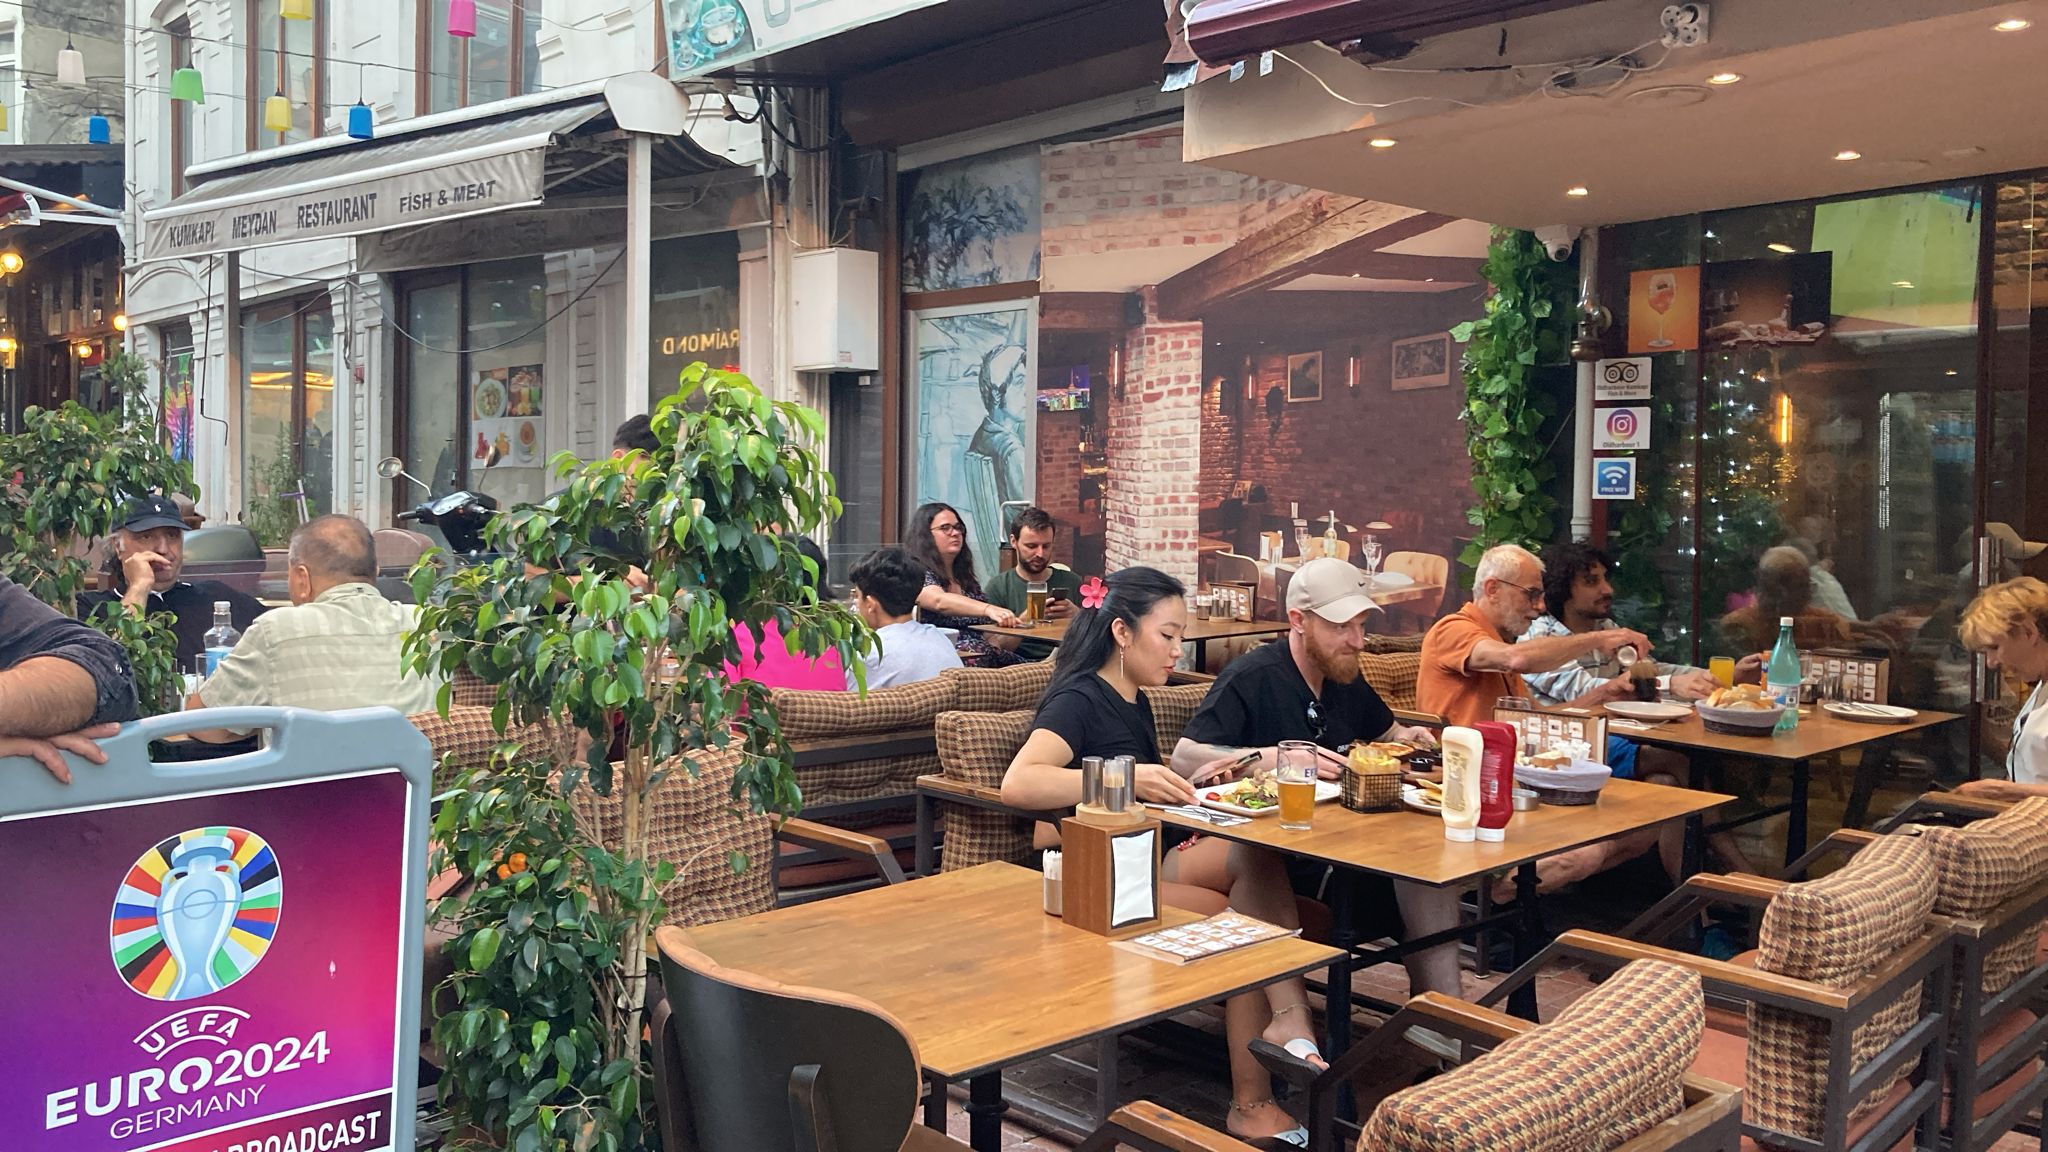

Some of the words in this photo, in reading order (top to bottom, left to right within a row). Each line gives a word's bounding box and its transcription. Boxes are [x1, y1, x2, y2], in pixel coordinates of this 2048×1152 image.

[169, 220, 215, 249] KUMKAPI
[232, 209, 277, 240] MEYDAN
[297, 192, 377, 229] RESTAURANT
[437, 189, 448, 206] &
[453, 179, 496, 203] MEAT
[139, 1013, 239, 1054] UEFA
[110, 1083, 267, 1139] GERMANY
[227, 1110, 382, 1152] OADCAST
